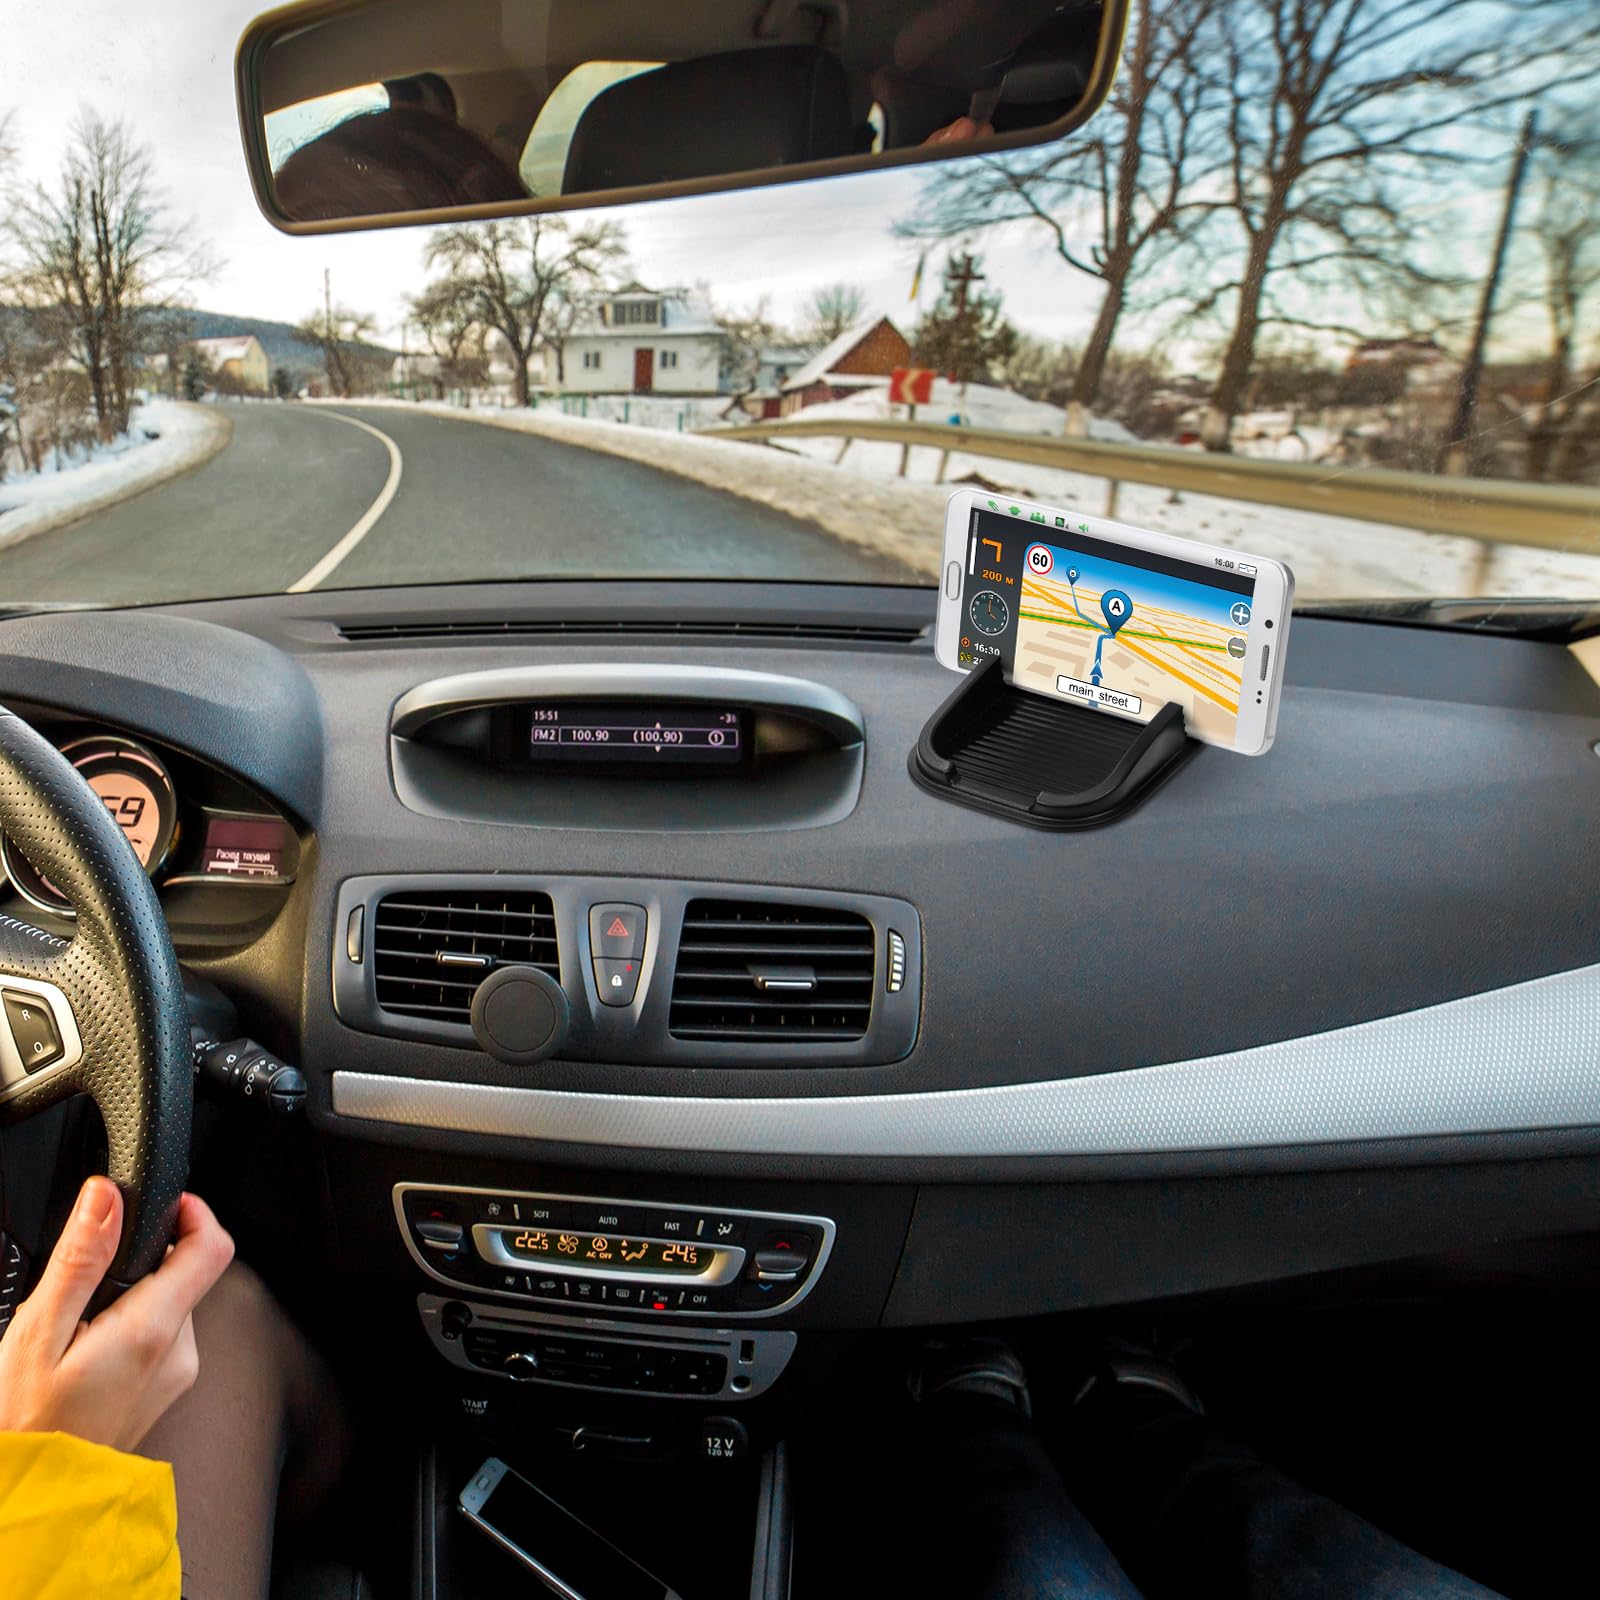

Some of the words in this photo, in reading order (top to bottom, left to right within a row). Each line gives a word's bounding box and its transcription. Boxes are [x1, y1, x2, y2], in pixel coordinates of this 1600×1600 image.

[1032, 552, 1048, 568] 60
[1214, 557, 1235, 569] 16:00
[982, 569, 1002, 582] 200
[1112, 600, 1121, 612] A
[974, 642, 1000, 656] 16:30
[1069, 683, 1094, 697] main
[1098, 692, 1129, 708] street
[534, 710, 558, 720] 15:51
[572, 729, 609, 741] 100.90
[633, 730, 683, 744] (100.90)
[22, 1009, 31, 1021] R
[533, 1210, 550, 1219] SOFT
[598, 1216, 618, 1225] AUTO
[664, 1222, 680, 1231] FAST
[599, 1252, 613, 1260] OFF
[693, 1295, 707, 1304] OFF
[707, 1437, 721, 1449] 12
[724, 1438, 734, 1449] V
[707, 1448, 722, 1457] 120
[724, 1449, 734, 1457] W
